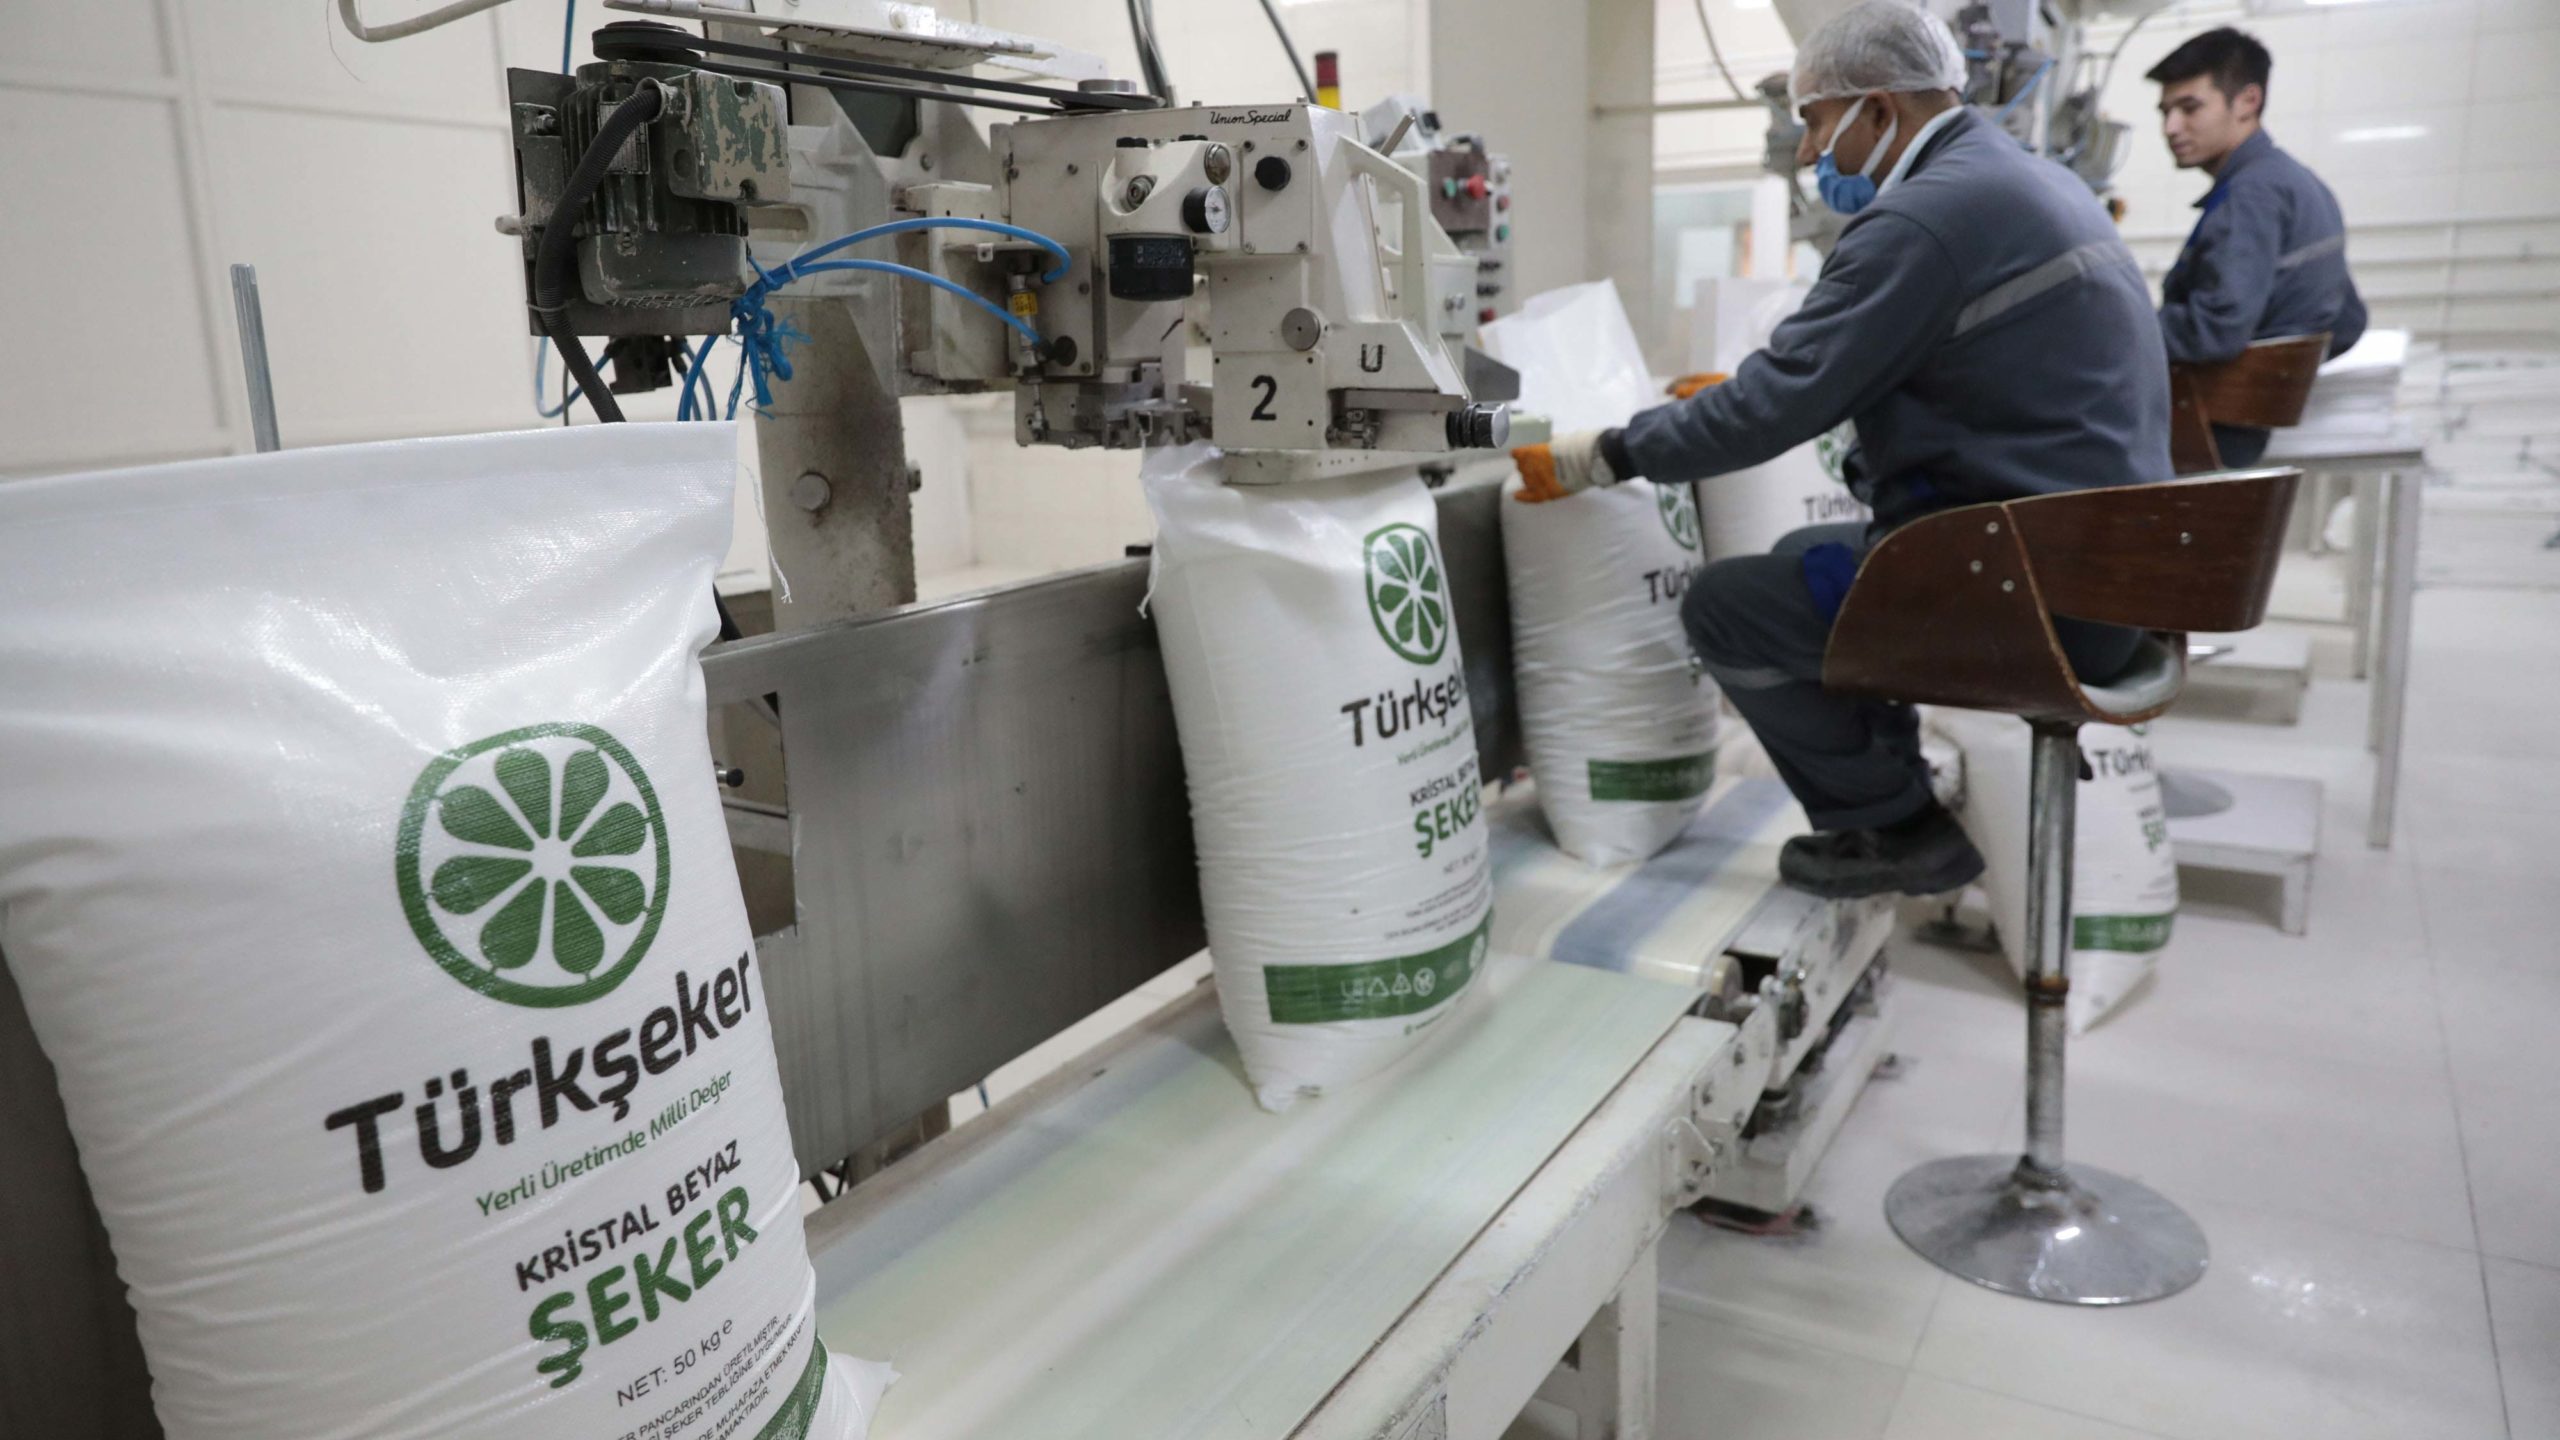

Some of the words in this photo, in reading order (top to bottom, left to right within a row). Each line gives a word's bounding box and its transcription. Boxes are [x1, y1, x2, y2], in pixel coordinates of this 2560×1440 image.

[1210, 110, 1245, 125] Union
[1243, 109, 1292, 126] Special
[1360, 343, 1384, 373] U
[1250, 374, 1277, 421] 2
[324, 950, 751, 1195] Türkşeker
[475, 1174, 537, 1218] Yerli
[541, 1130, 647, 1190] Üretimde
[650, 1097, 688, 1141] Milli
[689, 1070, 732, 1113] Değer
[515, 1203, 660, 1292] KRİSTAL
[665, 1139, 742, 1217] BEYAZ
[528, 1185, 759, 1390] ŞEKER
[617, 1366, 668, 1408] NET:
[673, 1348, 696, 1376] 50
[639, 1372, 723, 1438] PANCARINDAN
[715, 1376, 765, 1433] MUHAFAZA
[763, 1345, 790, 1381] ETMEK
